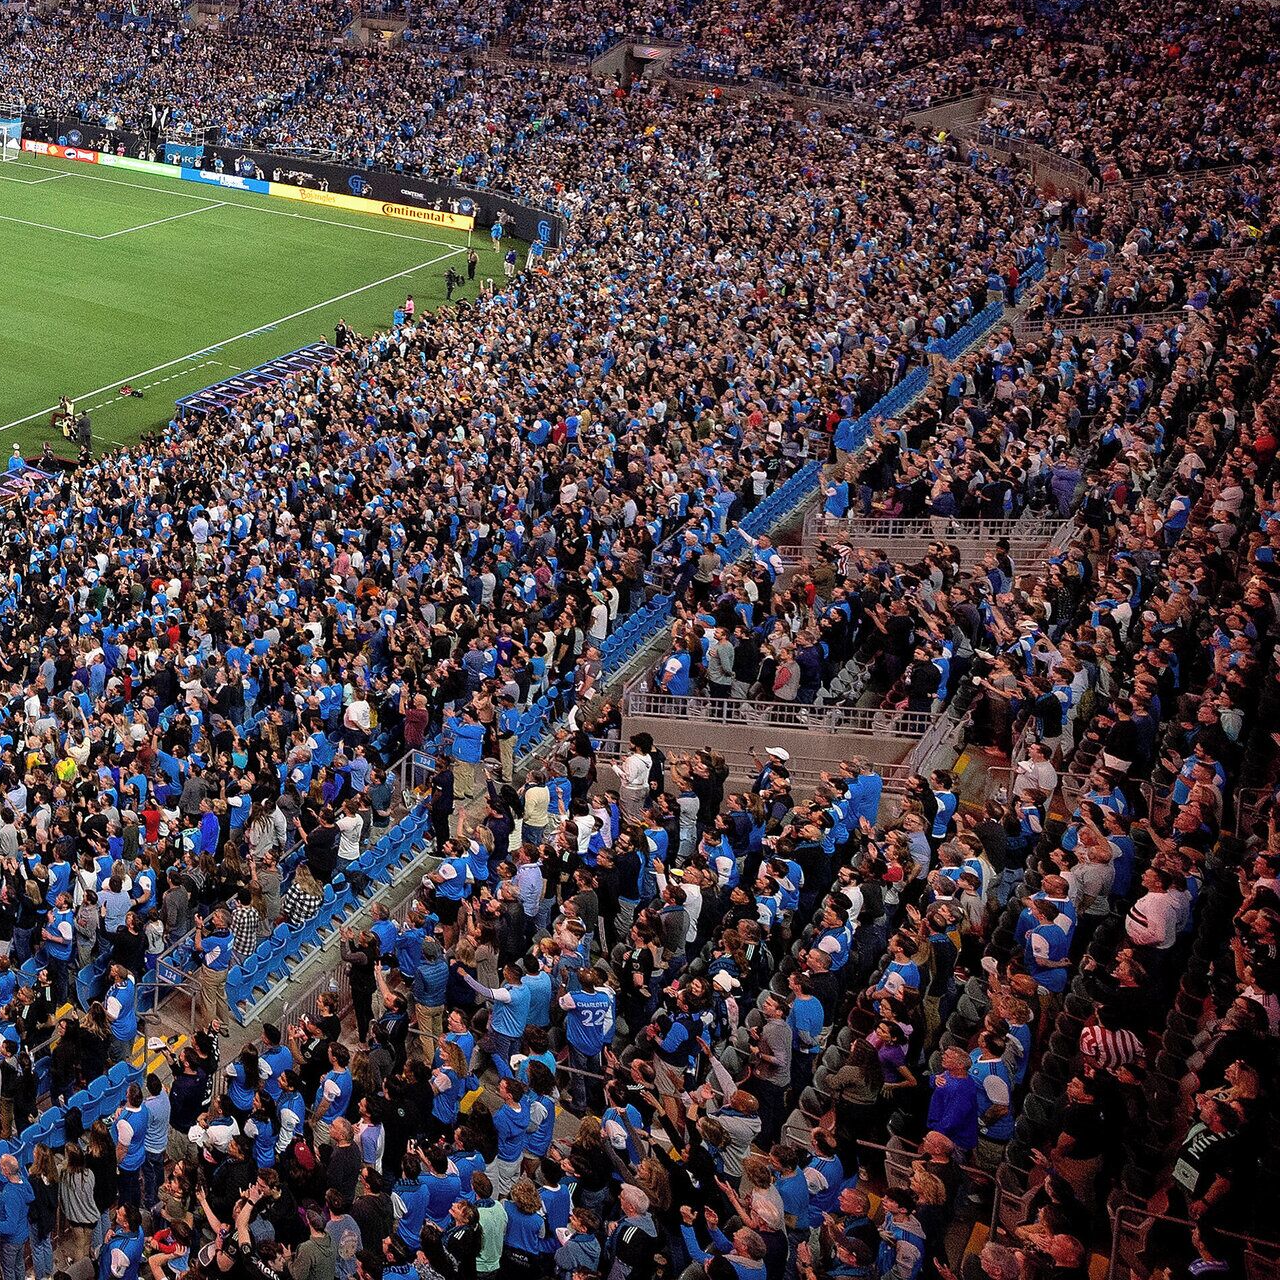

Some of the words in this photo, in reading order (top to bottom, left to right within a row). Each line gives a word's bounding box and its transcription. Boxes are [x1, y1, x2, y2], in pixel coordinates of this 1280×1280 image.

[381, 202, 446, 223] Continental
[420, 757, 431, 766] 134
[164, 970, 177, 981] 134
[580, 1009, 606, 1027] 22
